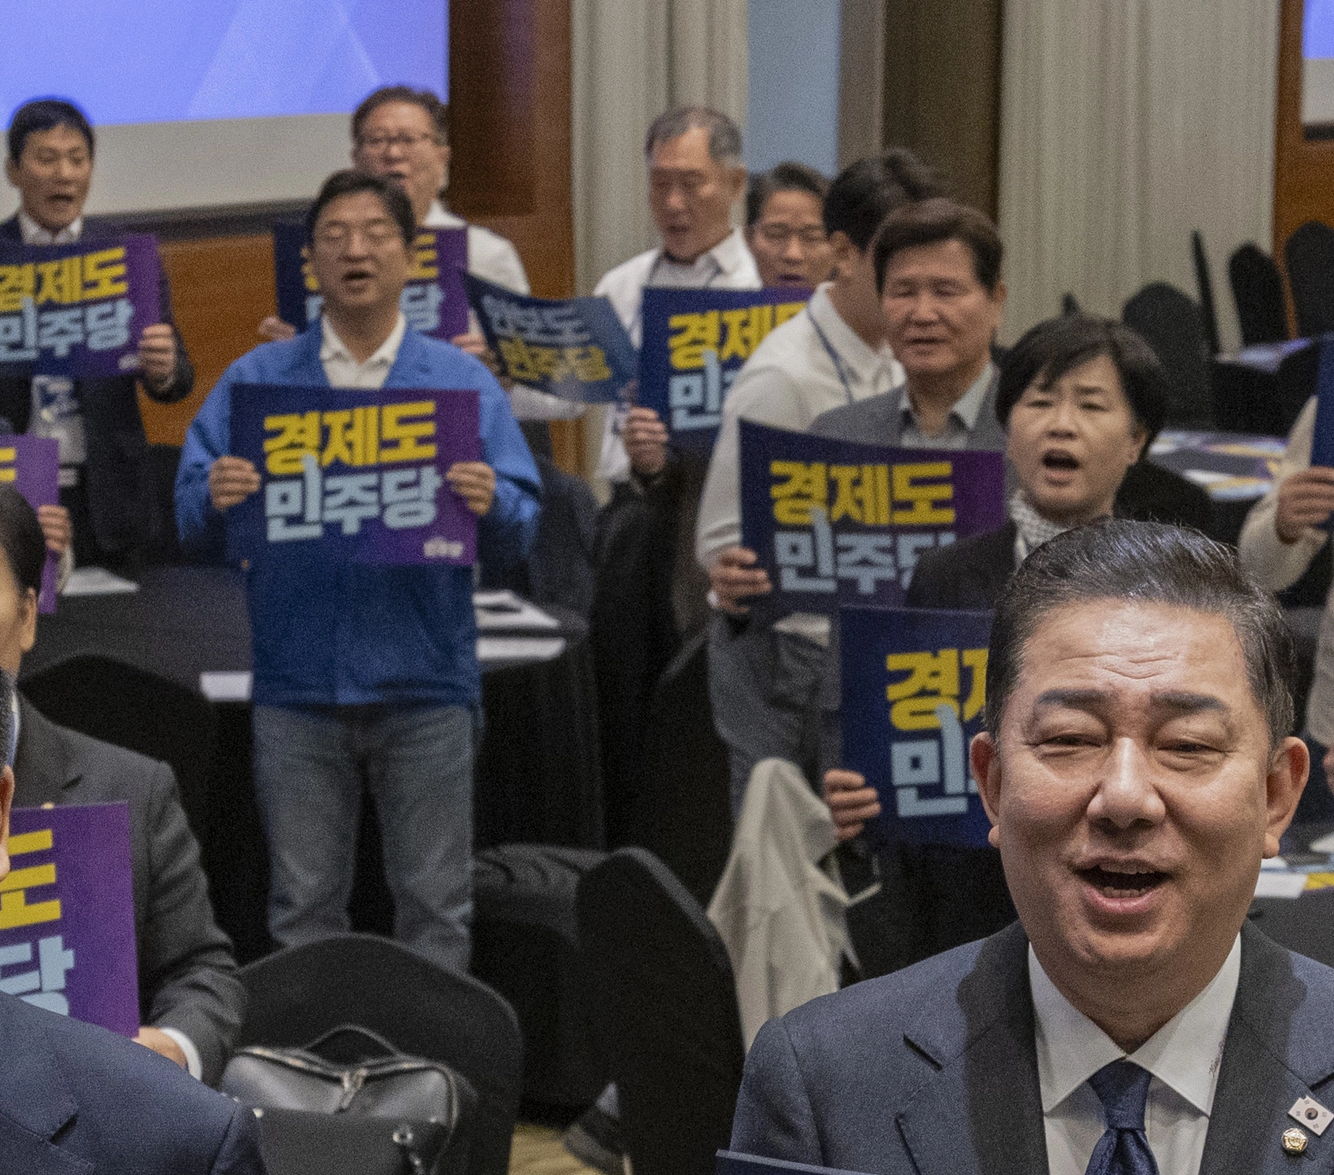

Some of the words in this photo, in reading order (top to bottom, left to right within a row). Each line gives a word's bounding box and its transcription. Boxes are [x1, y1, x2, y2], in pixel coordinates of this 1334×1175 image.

[263, 401, 437, 475] 경제도
[265, 454, 443, 542] 민주당
[770, 461, 955, 527] 경제도
